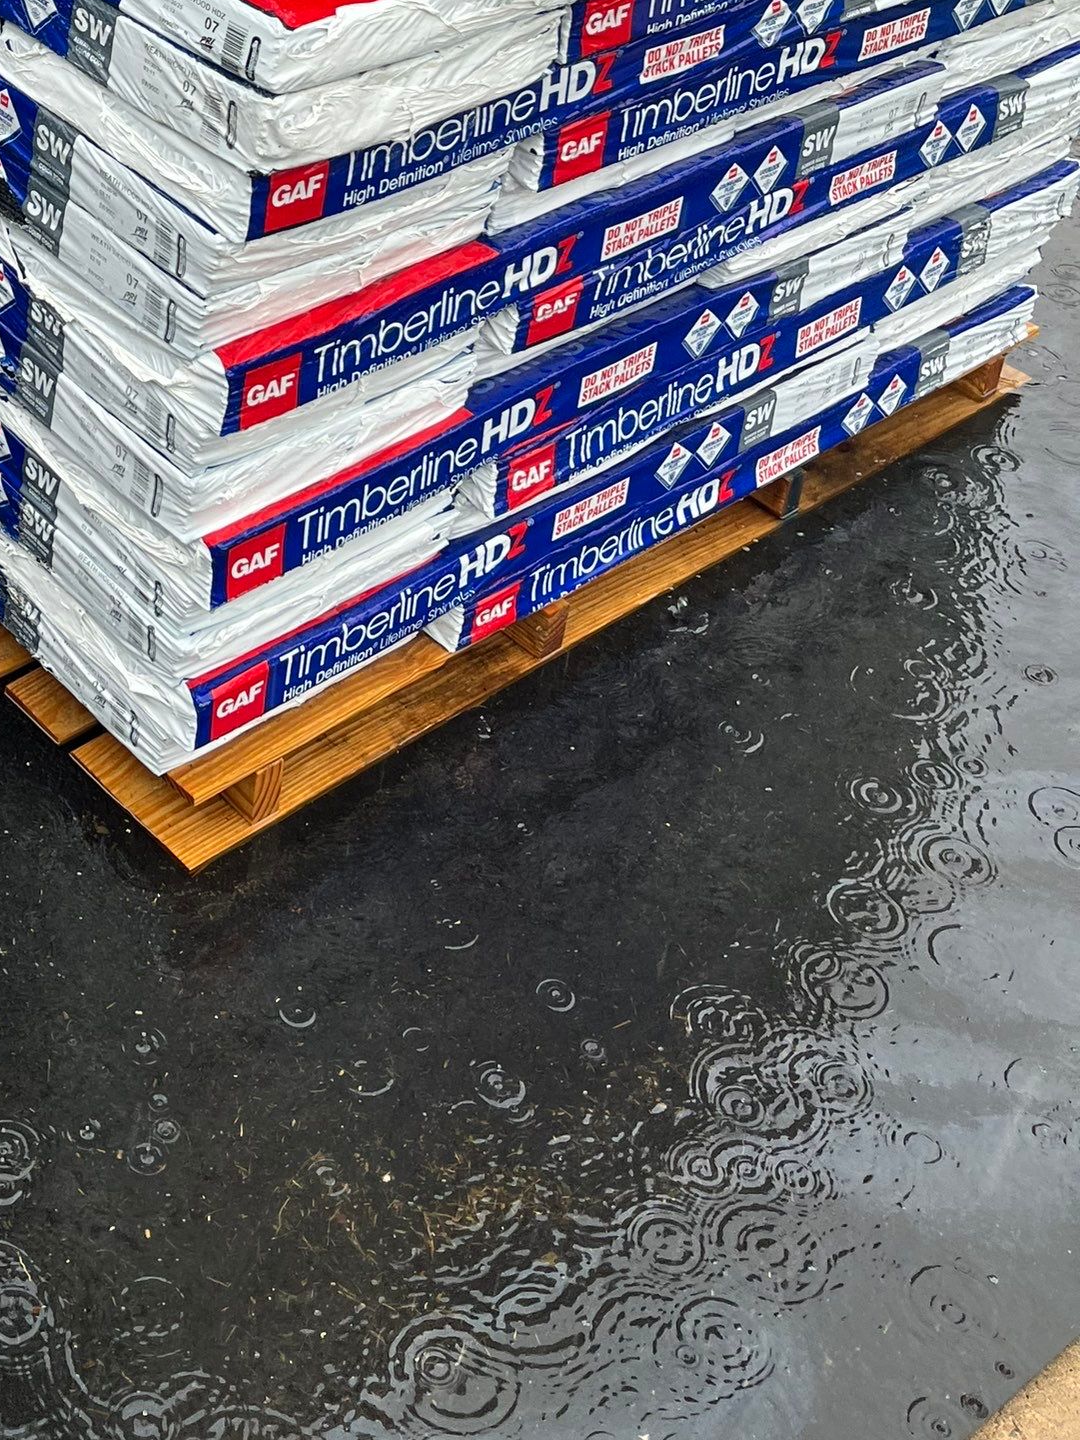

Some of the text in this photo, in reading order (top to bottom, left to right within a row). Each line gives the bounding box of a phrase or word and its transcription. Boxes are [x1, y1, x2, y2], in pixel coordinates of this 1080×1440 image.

[74, 7, 113, 48] SW
[204, 17, 220, 33] 07
[584, 3, 631, 33] GAF
[559, 31, 841, 162] GAF Timberline HDZ
[36, 123, 72, 165] SW
[271, 53, 617, 208] GAF Timberline HDZ
[802, 125, 836, 159] SW
[26, 189, 62, 231] SW
[607, 201, 680, 241] DO NOT TRIPLE
[593, 178, 810, 301] Timberline HDZ
[604, 216, 677, 257] STACK PALLETS
[246, 235, 578, 407] GAF Timberline HDZ
[512, 334, 777, 492] GAF Timberline HDZ
[744, 400, 775, 430] SW
[25, 456, 57, 496] SW
[231, 384, 555, 579] GAF Timberline HDZ
[475, 466, 738, 627] GAF Timberline HDZ
[215, 519, 528, 719] GAF Timberline HDZ
[282, 679, 313, 703] High
[315, 647, 374, 687] Definition
